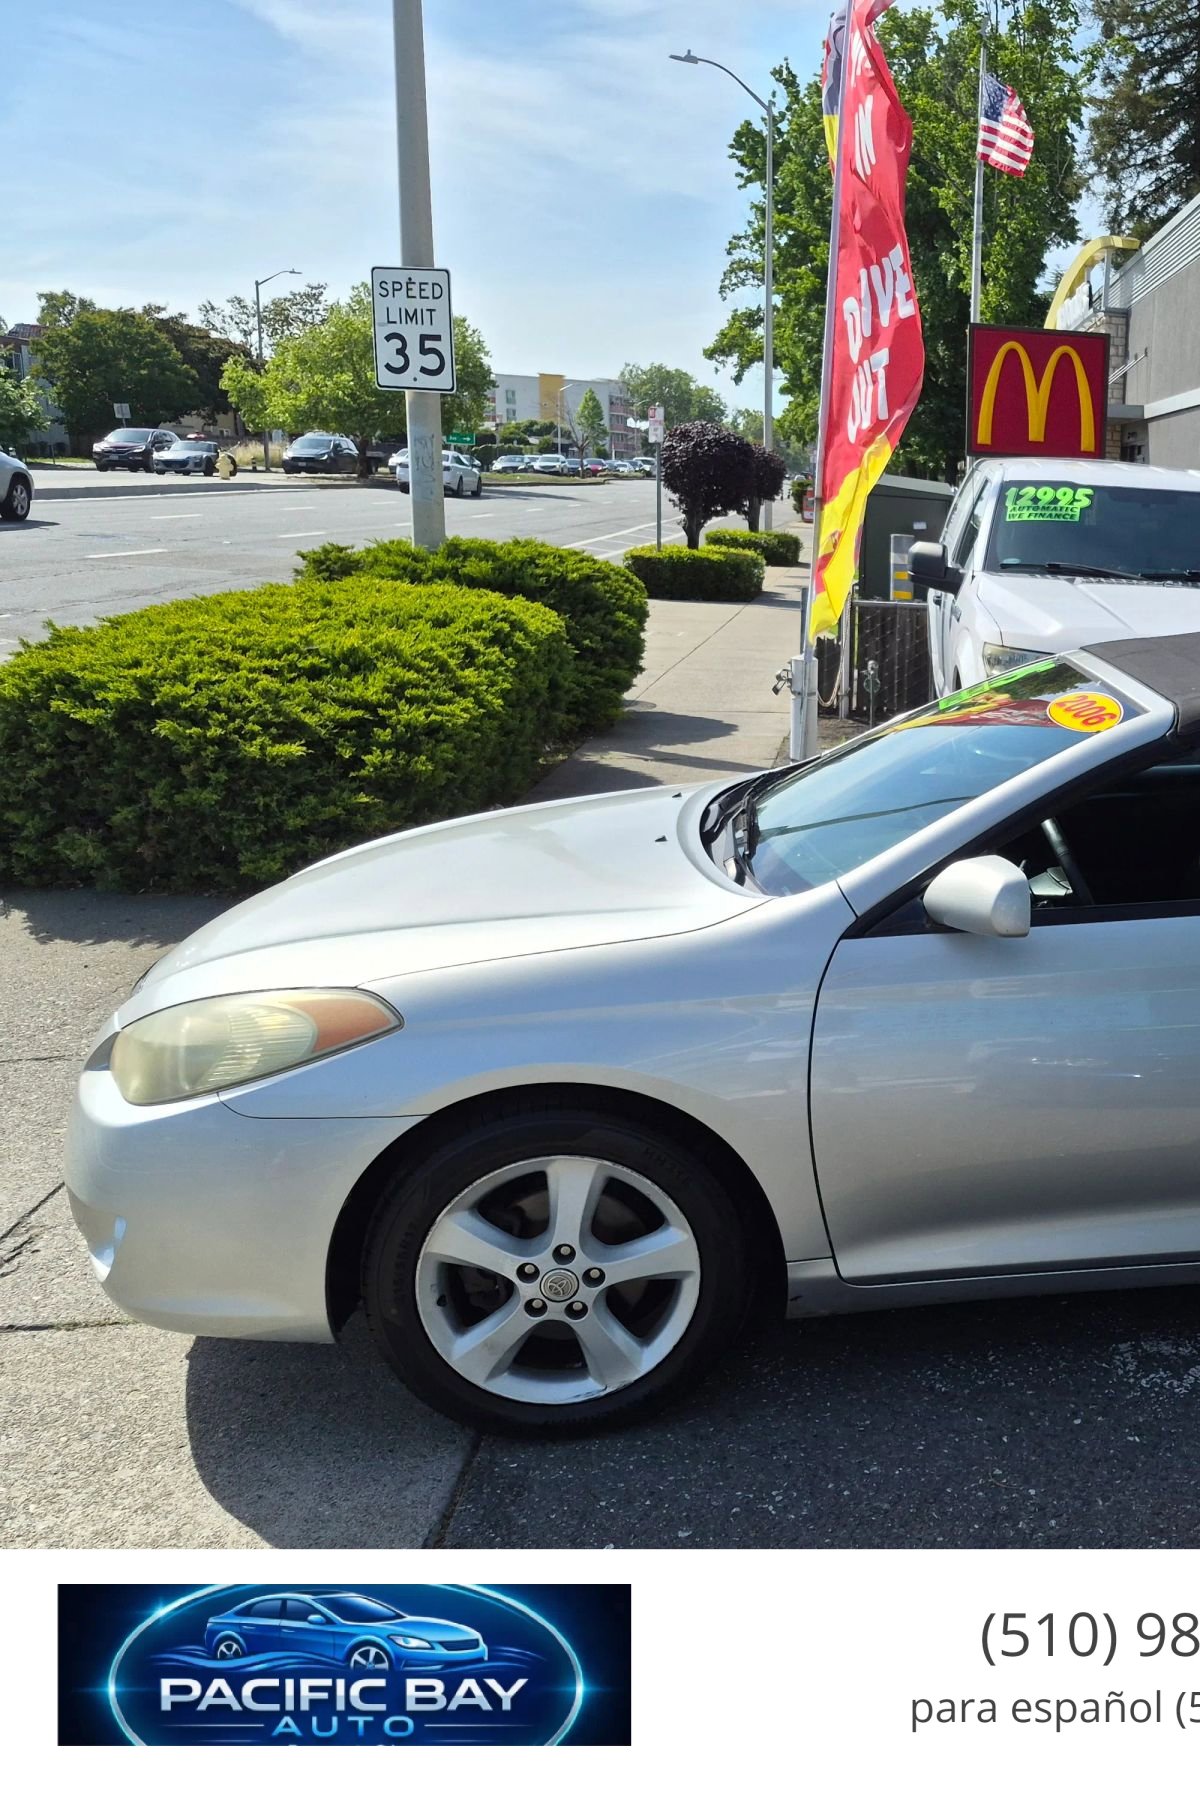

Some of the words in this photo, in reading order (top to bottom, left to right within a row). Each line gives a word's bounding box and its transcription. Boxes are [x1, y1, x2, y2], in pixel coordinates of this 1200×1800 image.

[378, 280, 444, 300] SPEED
[386, 306, 437, 326] LIMIT
[383, 332, 446, 377] 35
[847, 347, 890, 444] OUT
[1004, 486, 1094, 508] 12995
[1009, 505, 1079, 513] AUTOMATIC
[1027, 512, 1078, 520] FINANCE
[1053, 695, 1118, 726] 2006
